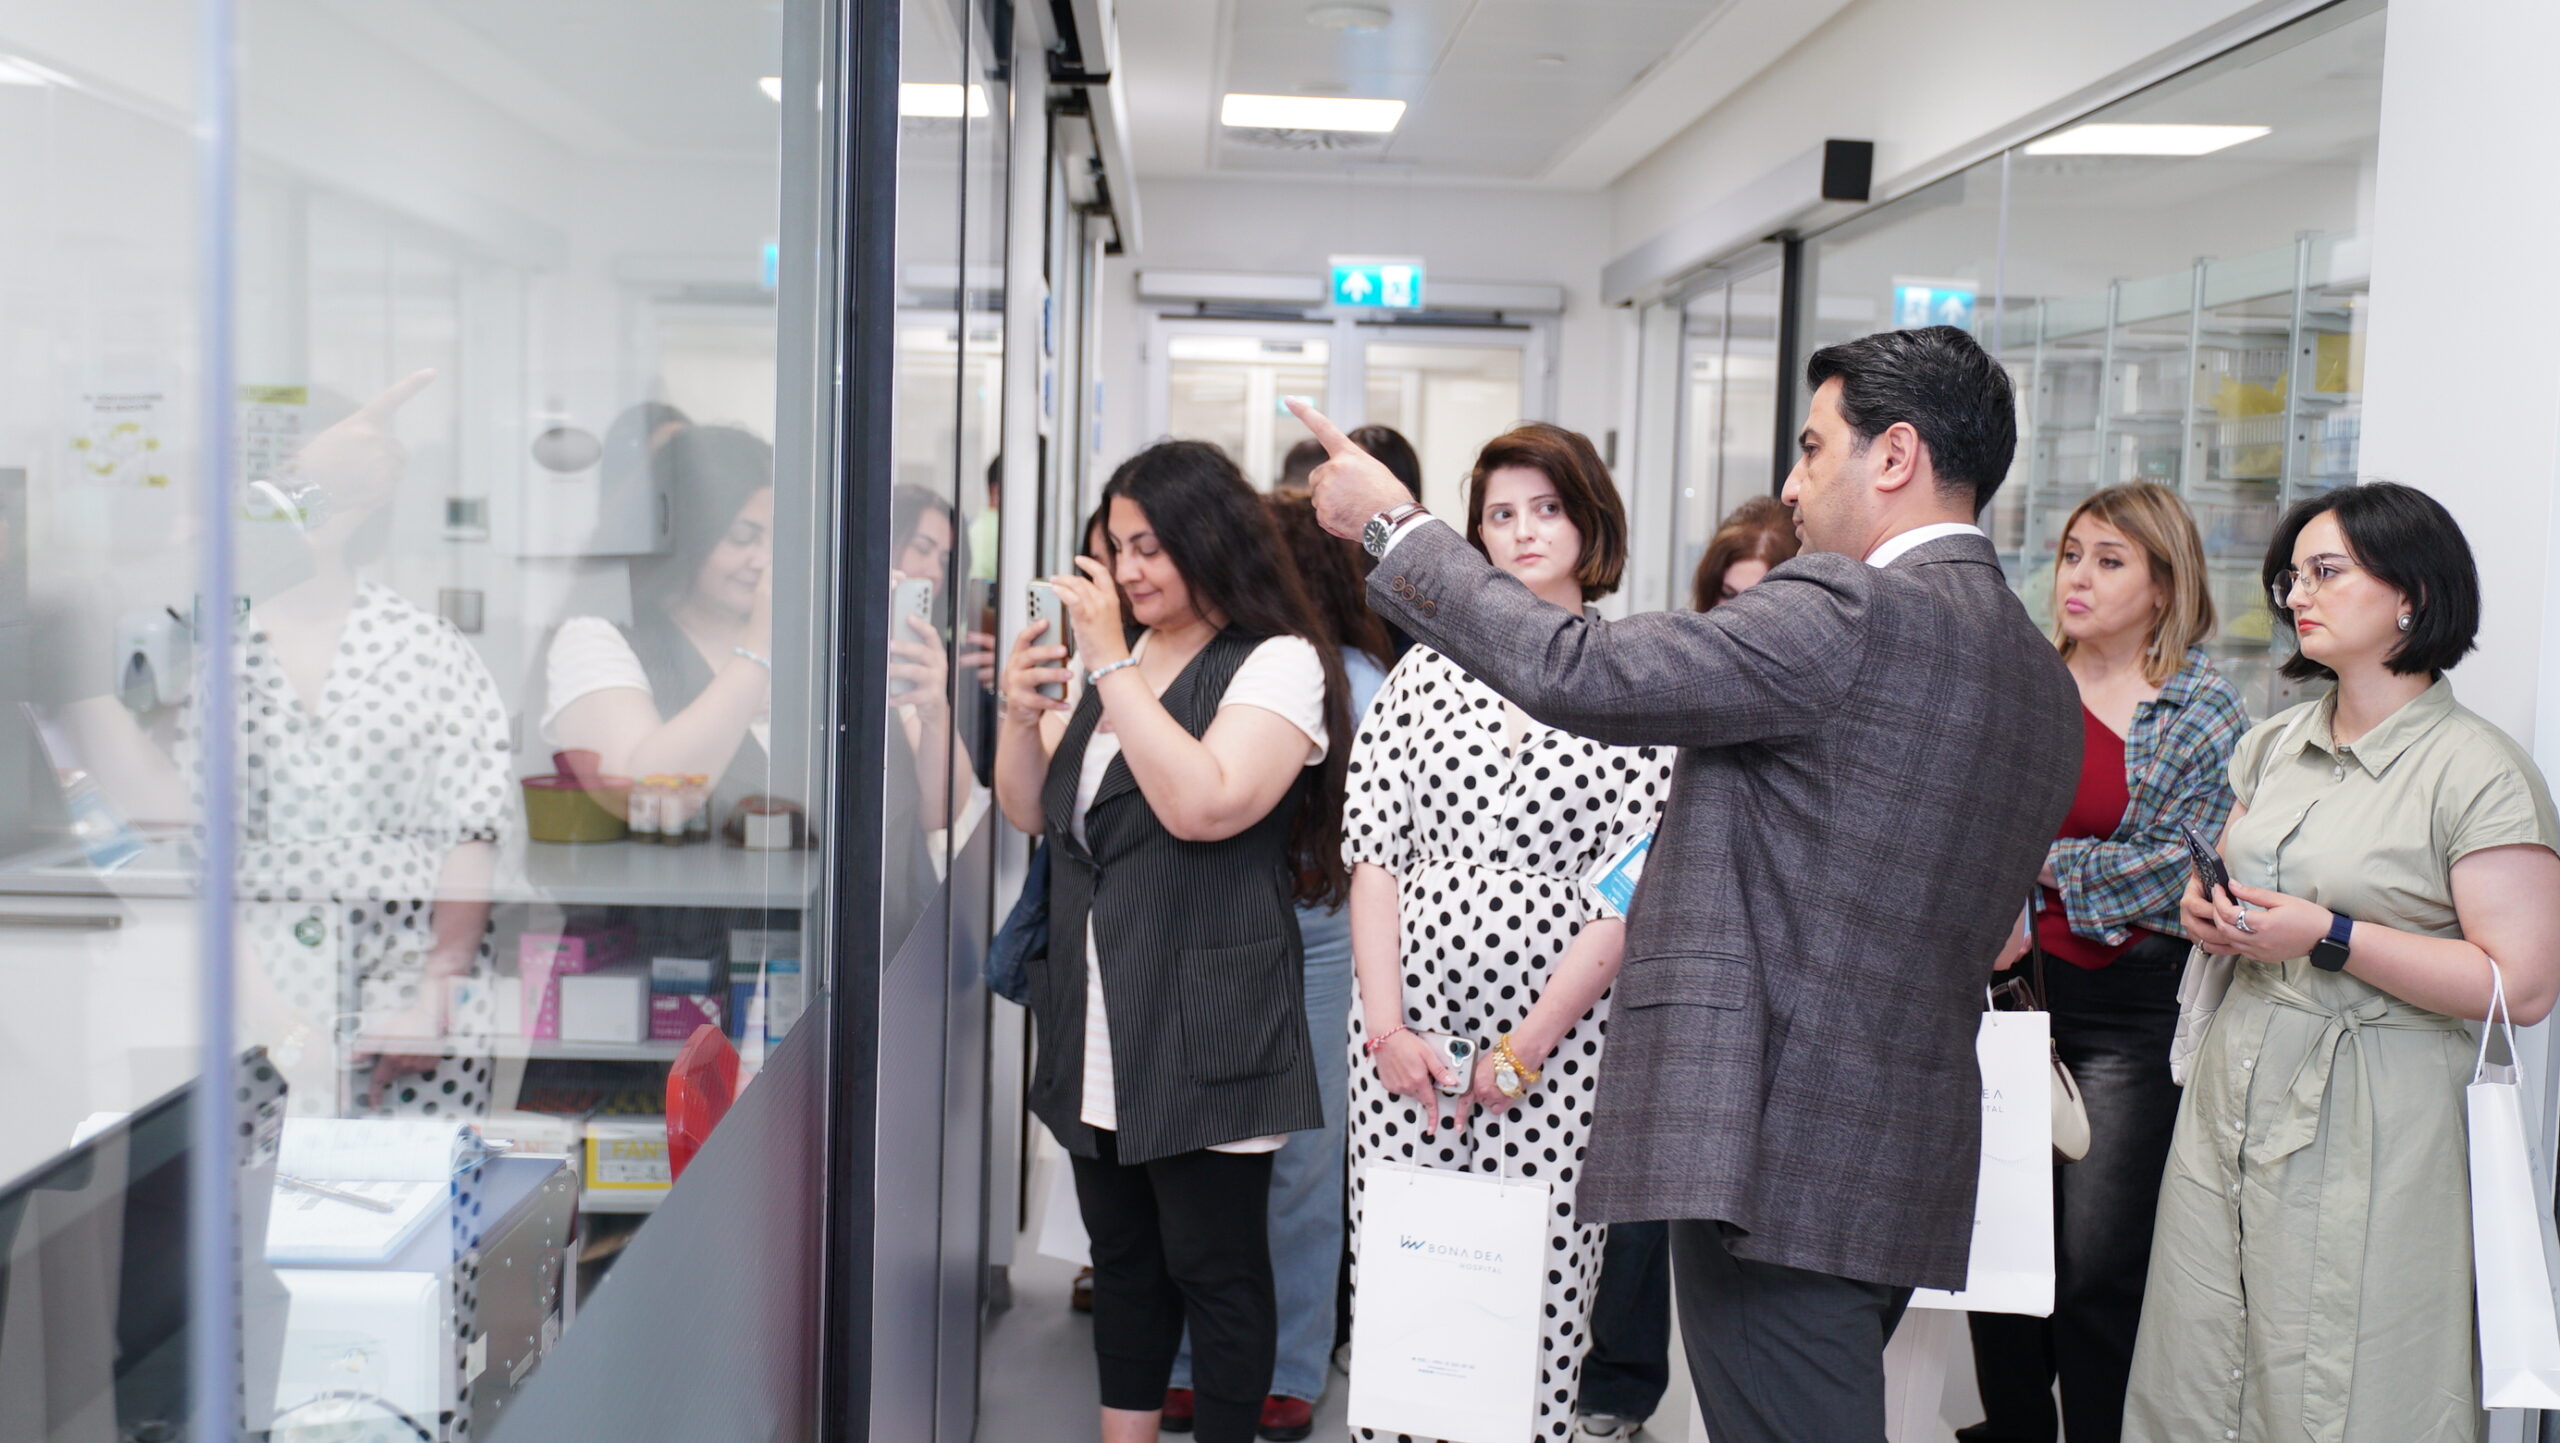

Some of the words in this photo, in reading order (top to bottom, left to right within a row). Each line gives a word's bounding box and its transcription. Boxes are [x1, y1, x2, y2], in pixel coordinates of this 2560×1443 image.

[1428, 1243, 1469, 1258] BONA
[1474, 1249, 1503, 1263] DEA
[1458, 1262, 1503, 1275] HOSPITAL
